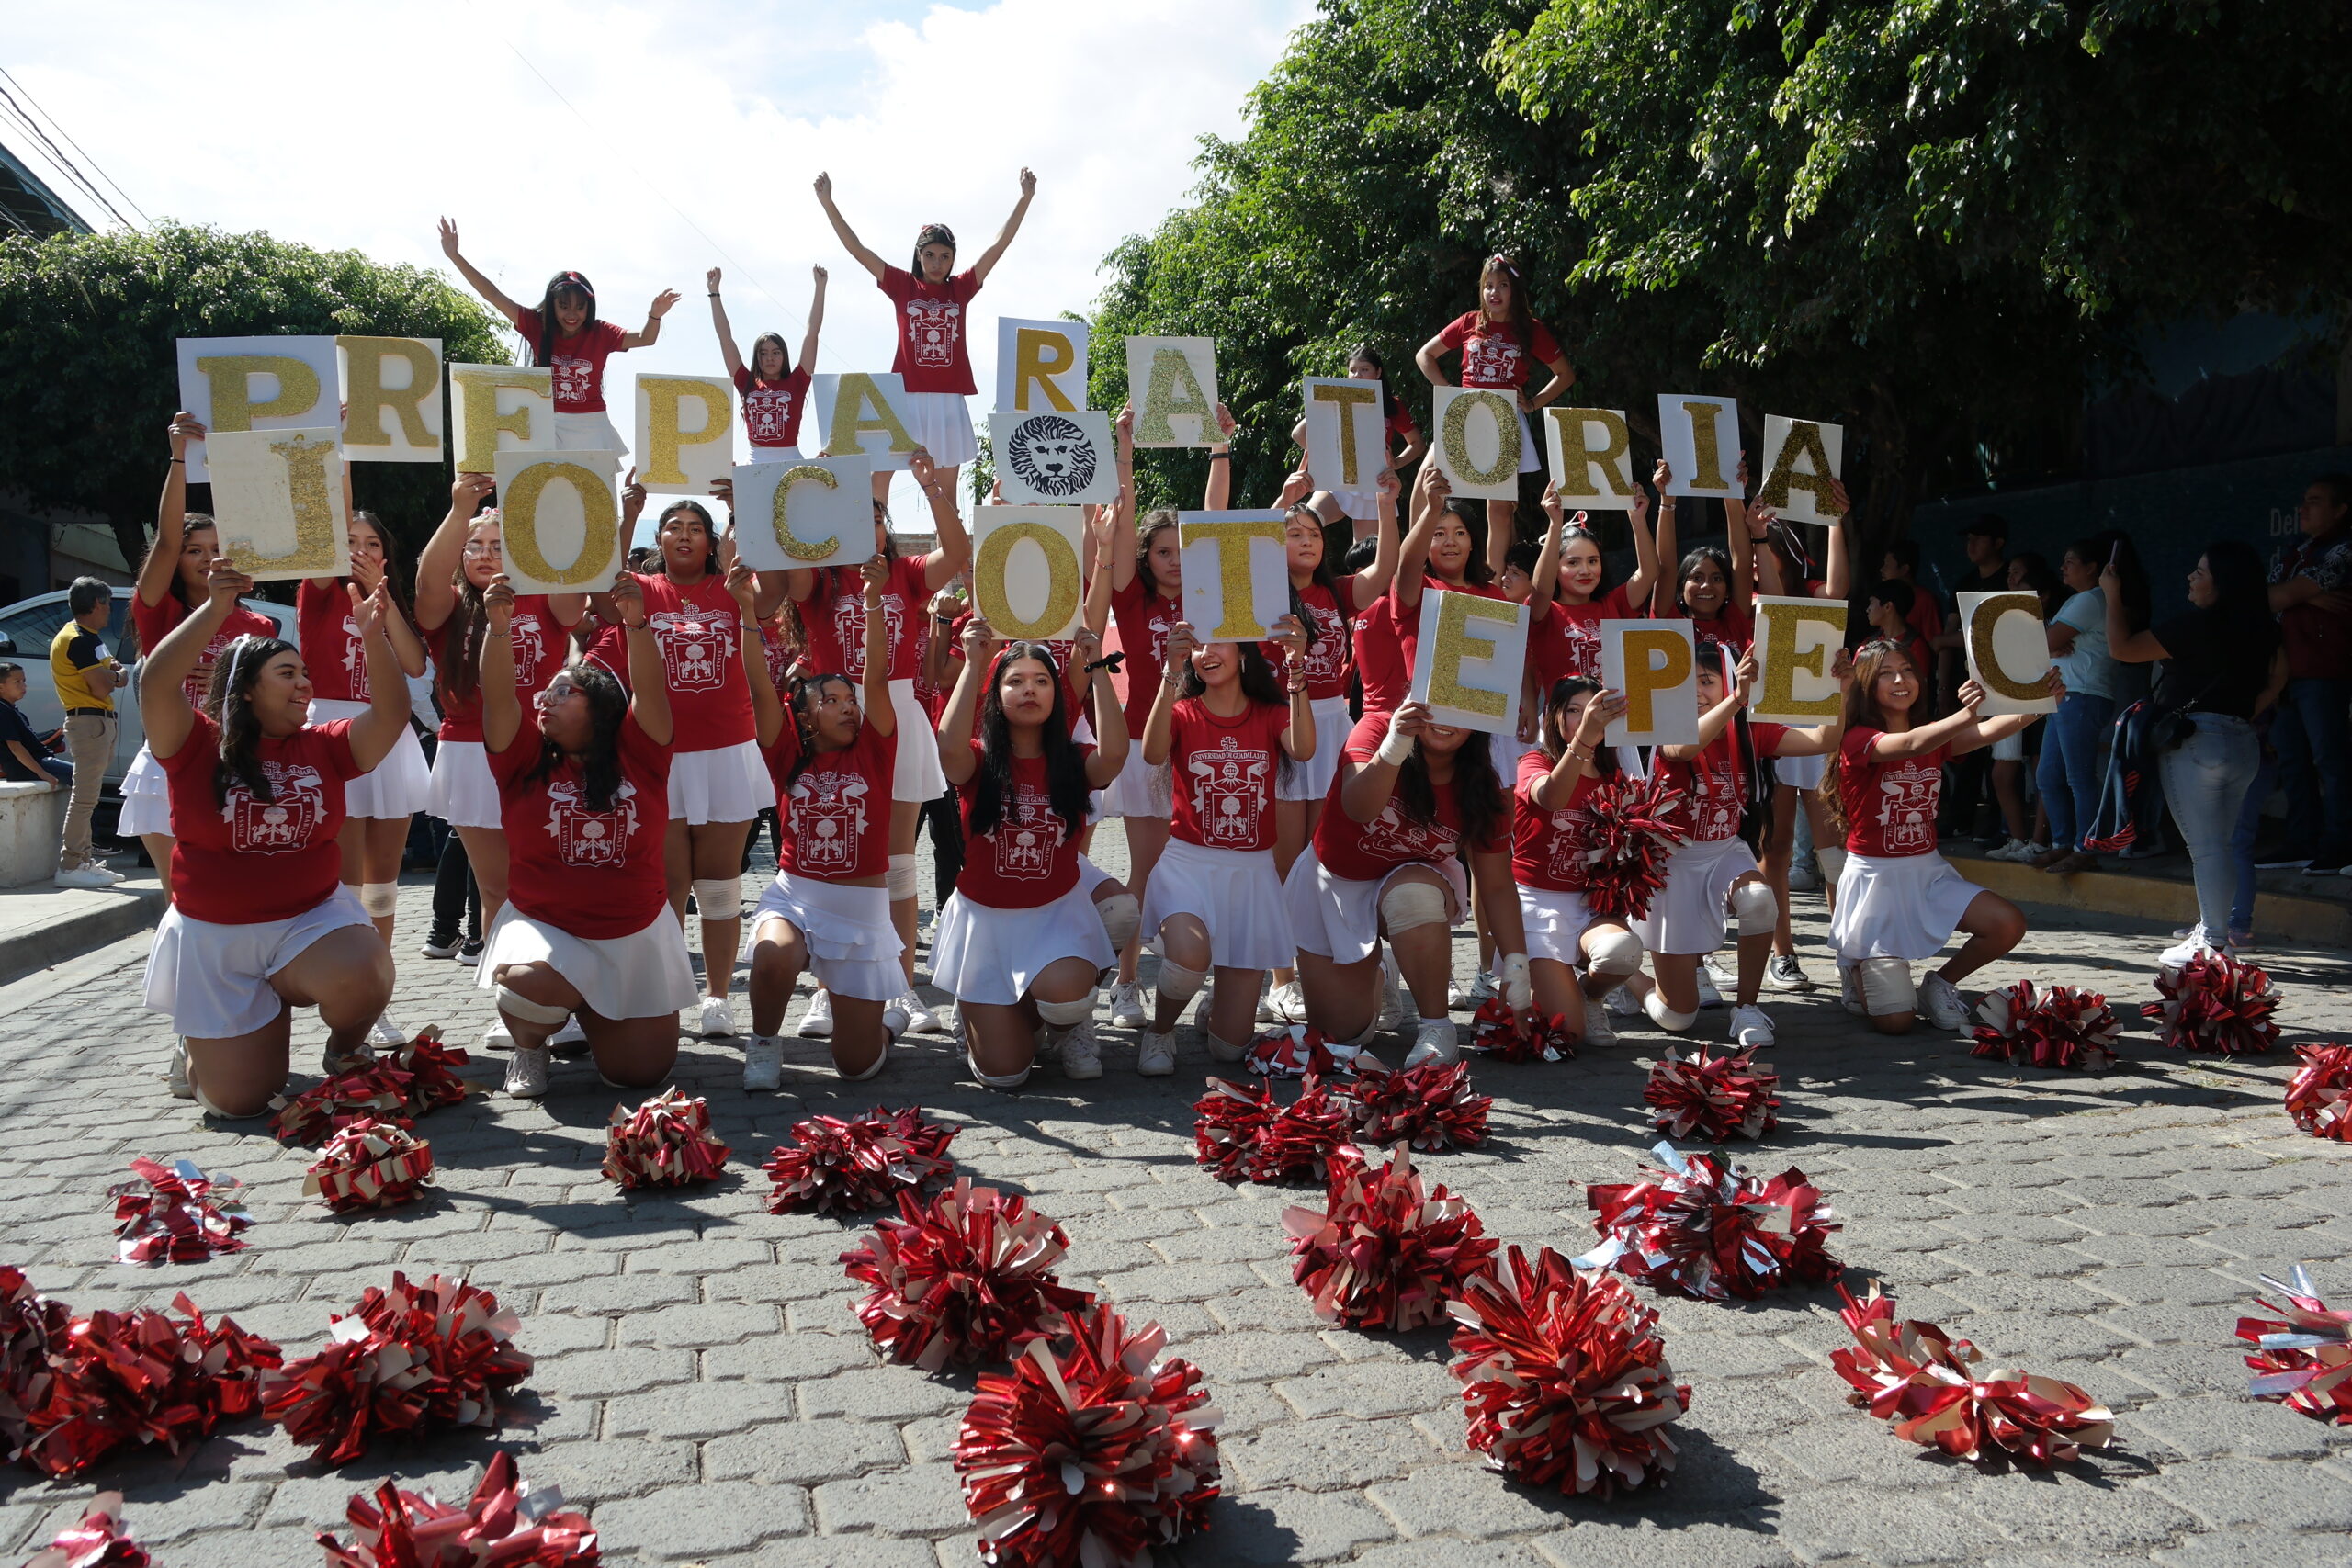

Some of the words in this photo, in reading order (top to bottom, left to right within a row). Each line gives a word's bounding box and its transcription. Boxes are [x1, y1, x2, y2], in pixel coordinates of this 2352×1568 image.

[337, 334, 441, 449] R
[639, 378, 731, 486] P
[823, 372, 921, 456] A
[1014, 328, 1079, 412] R
[1134, 347, 1225, 445] A
[1313, 384, 1376, 486] T
[1442, 390, 1521, 487] O
[1549, 408, 1636, 497] R
[1681, 401, 1729, 490] I
[1760, 421, 1843, 517] A
[224, 434, 336, 574] J
[503, 461, 618, 586] O
[773, 465, 840, 561] C
[975, 521, 1080, 640] O
[1180, 520, 1287, 639] T
[1427, 590, 1520, 720] E
[1622, 630, 1693, 734] P
[1753, 604, 1848, 717] E
[1972, 594, 2052, 700] C
